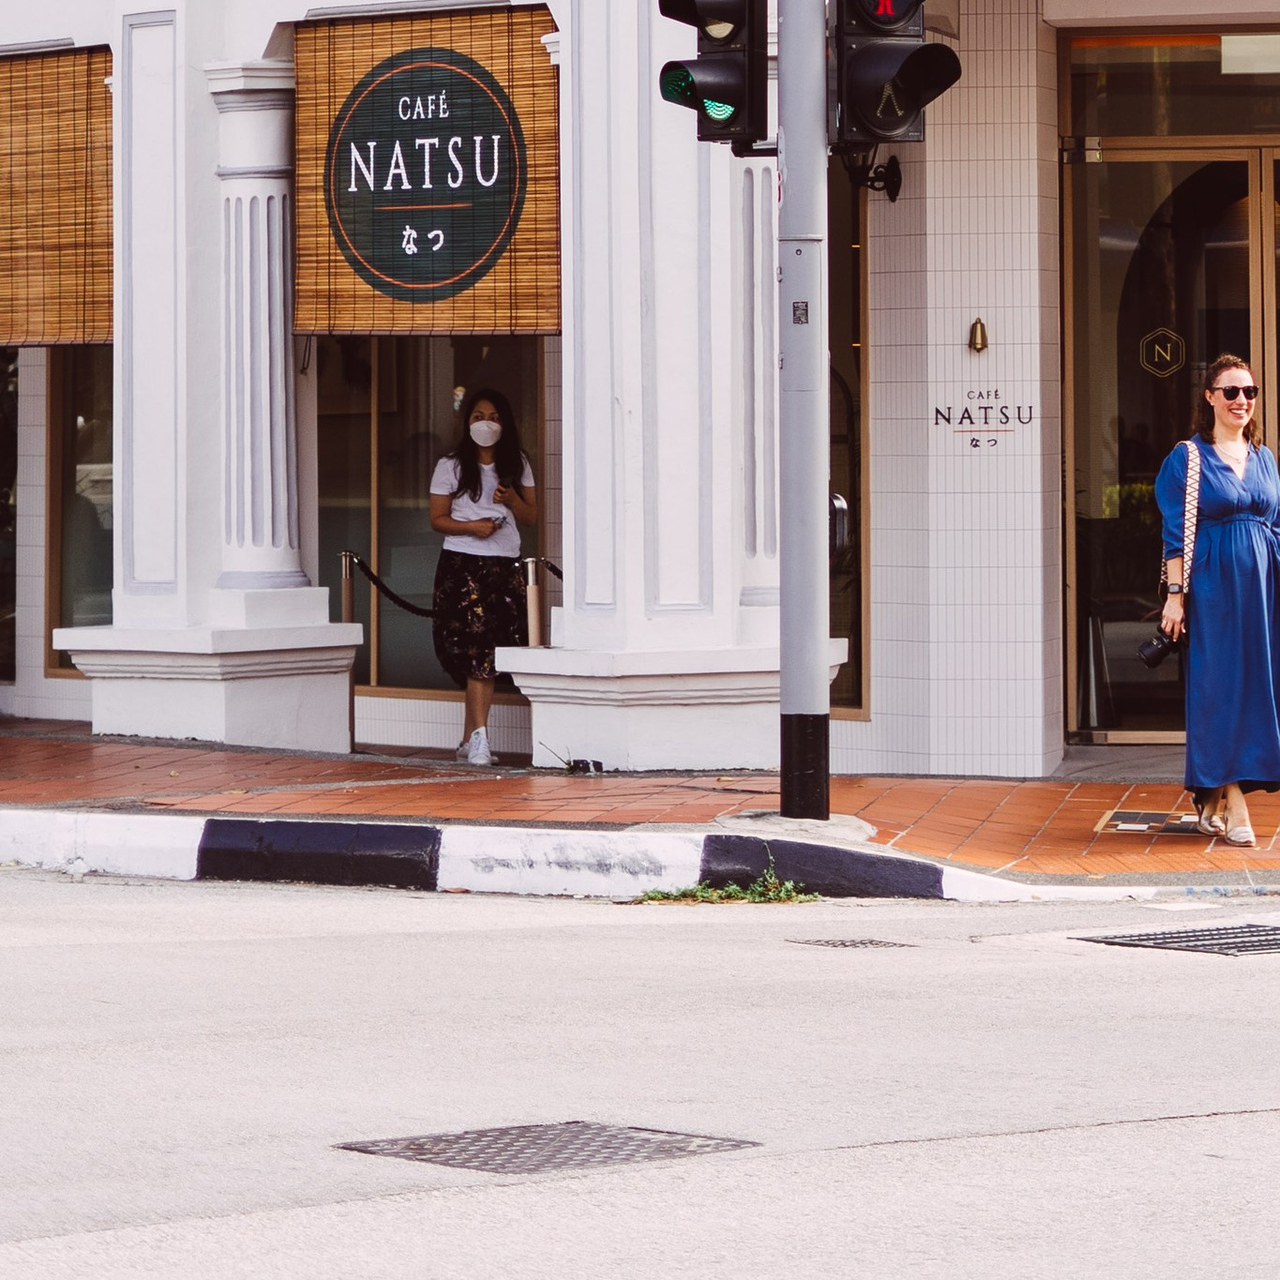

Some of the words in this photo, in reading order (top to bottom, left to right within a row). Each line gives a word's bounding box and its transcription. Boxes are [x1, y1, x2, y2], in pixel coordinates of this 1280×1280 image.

[398, 90, 449, 120] CAFÉ
[348, 135, 501, 191] NATSU
[402, 225, 444, 255] なつ
[1154, 342, 1172, 362] N
[967, 388, 1001, 400] CAFÉ
[934, 405, 1033, 425] NATSU
[970, 437, 998, 448] なつ
